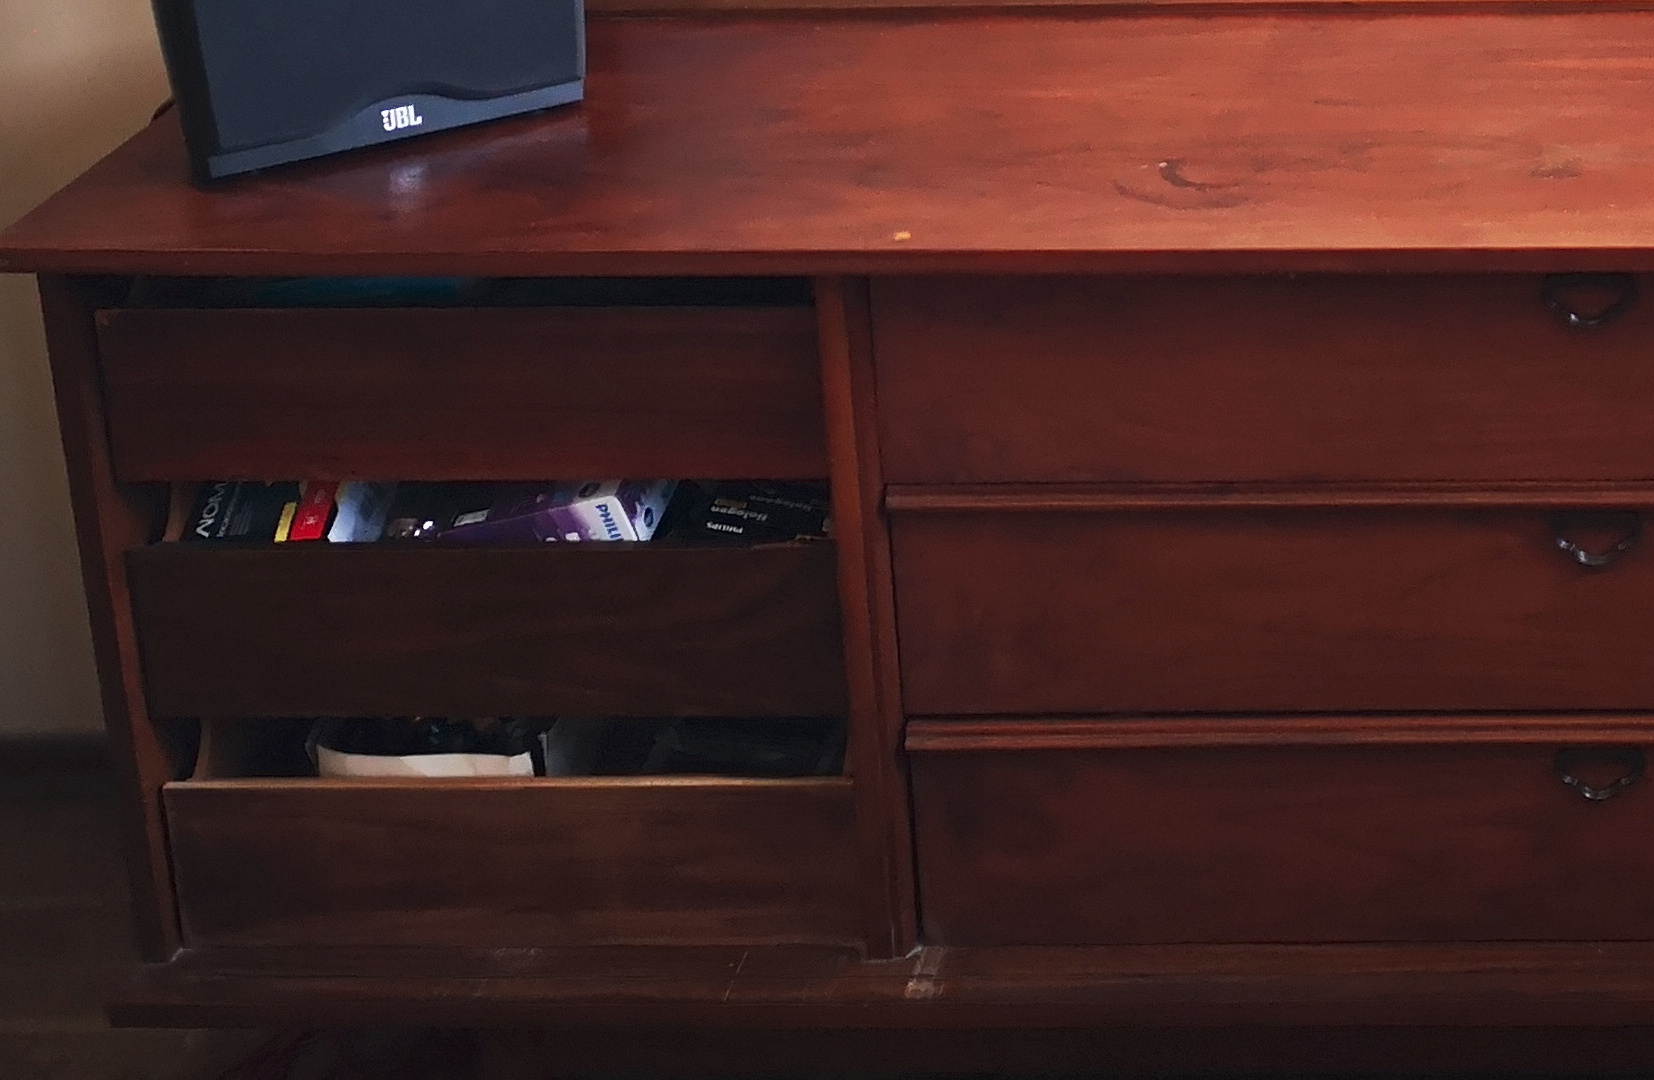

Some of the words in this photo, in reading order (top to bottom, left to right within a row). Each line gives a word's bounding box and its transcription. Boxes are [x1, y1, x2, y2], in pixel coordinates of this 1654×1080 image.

[381, 104, 422, 131] JBL
[595, 503, 623, 540] PHILI
[706, 521, 743, 534] PHILIPS
